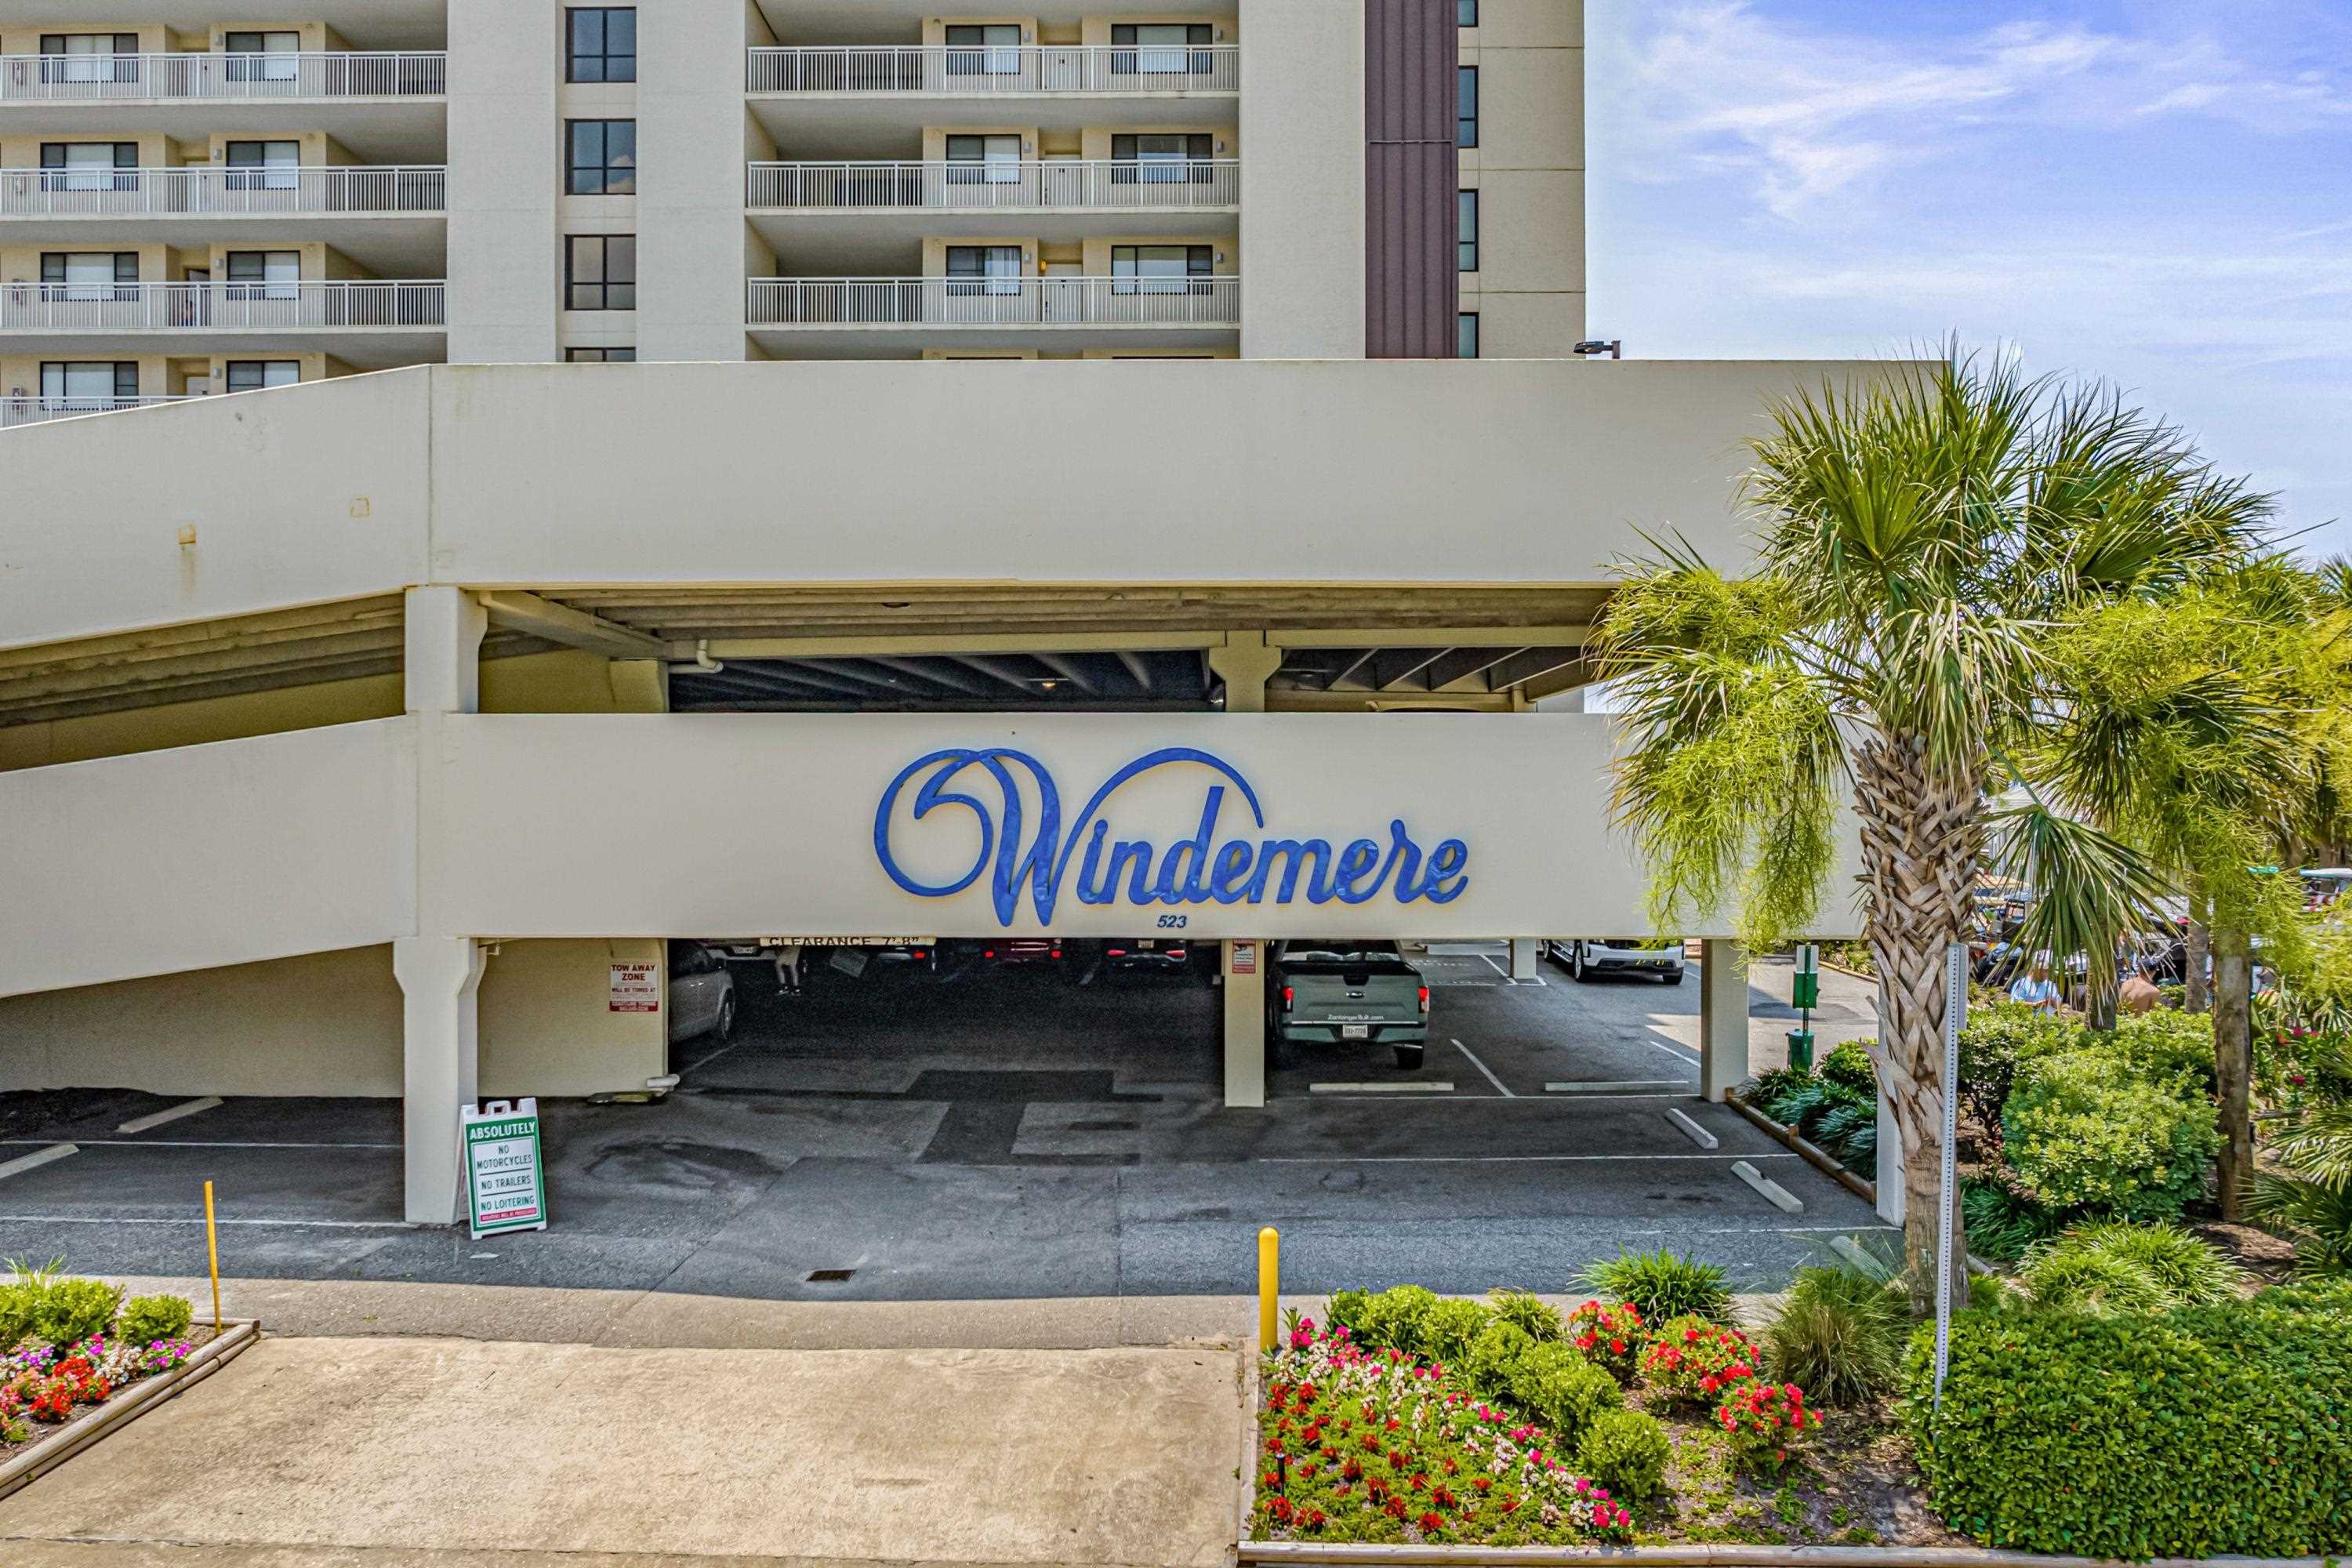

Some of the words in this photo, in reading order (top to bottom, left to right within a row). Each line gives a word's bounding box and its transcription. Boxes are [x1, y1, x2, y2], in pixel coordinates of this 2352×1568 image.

[874, 746, 1468, 927] Windemere
[1156, 914, 1188, 928] 523
[470, 1122, 535, 1140] ABSOLUTELY
[498, 1145, 510, 1155] NO
[477, 1154, 533, 1169] MOTORCYCLES
[481, 1180, 493, 1189] NO
[495, 1175, 532, 1188] TRAILERS
[481, 1201, 492, 1211] NO
[494, 1195, 535, 1210] LOITERING
